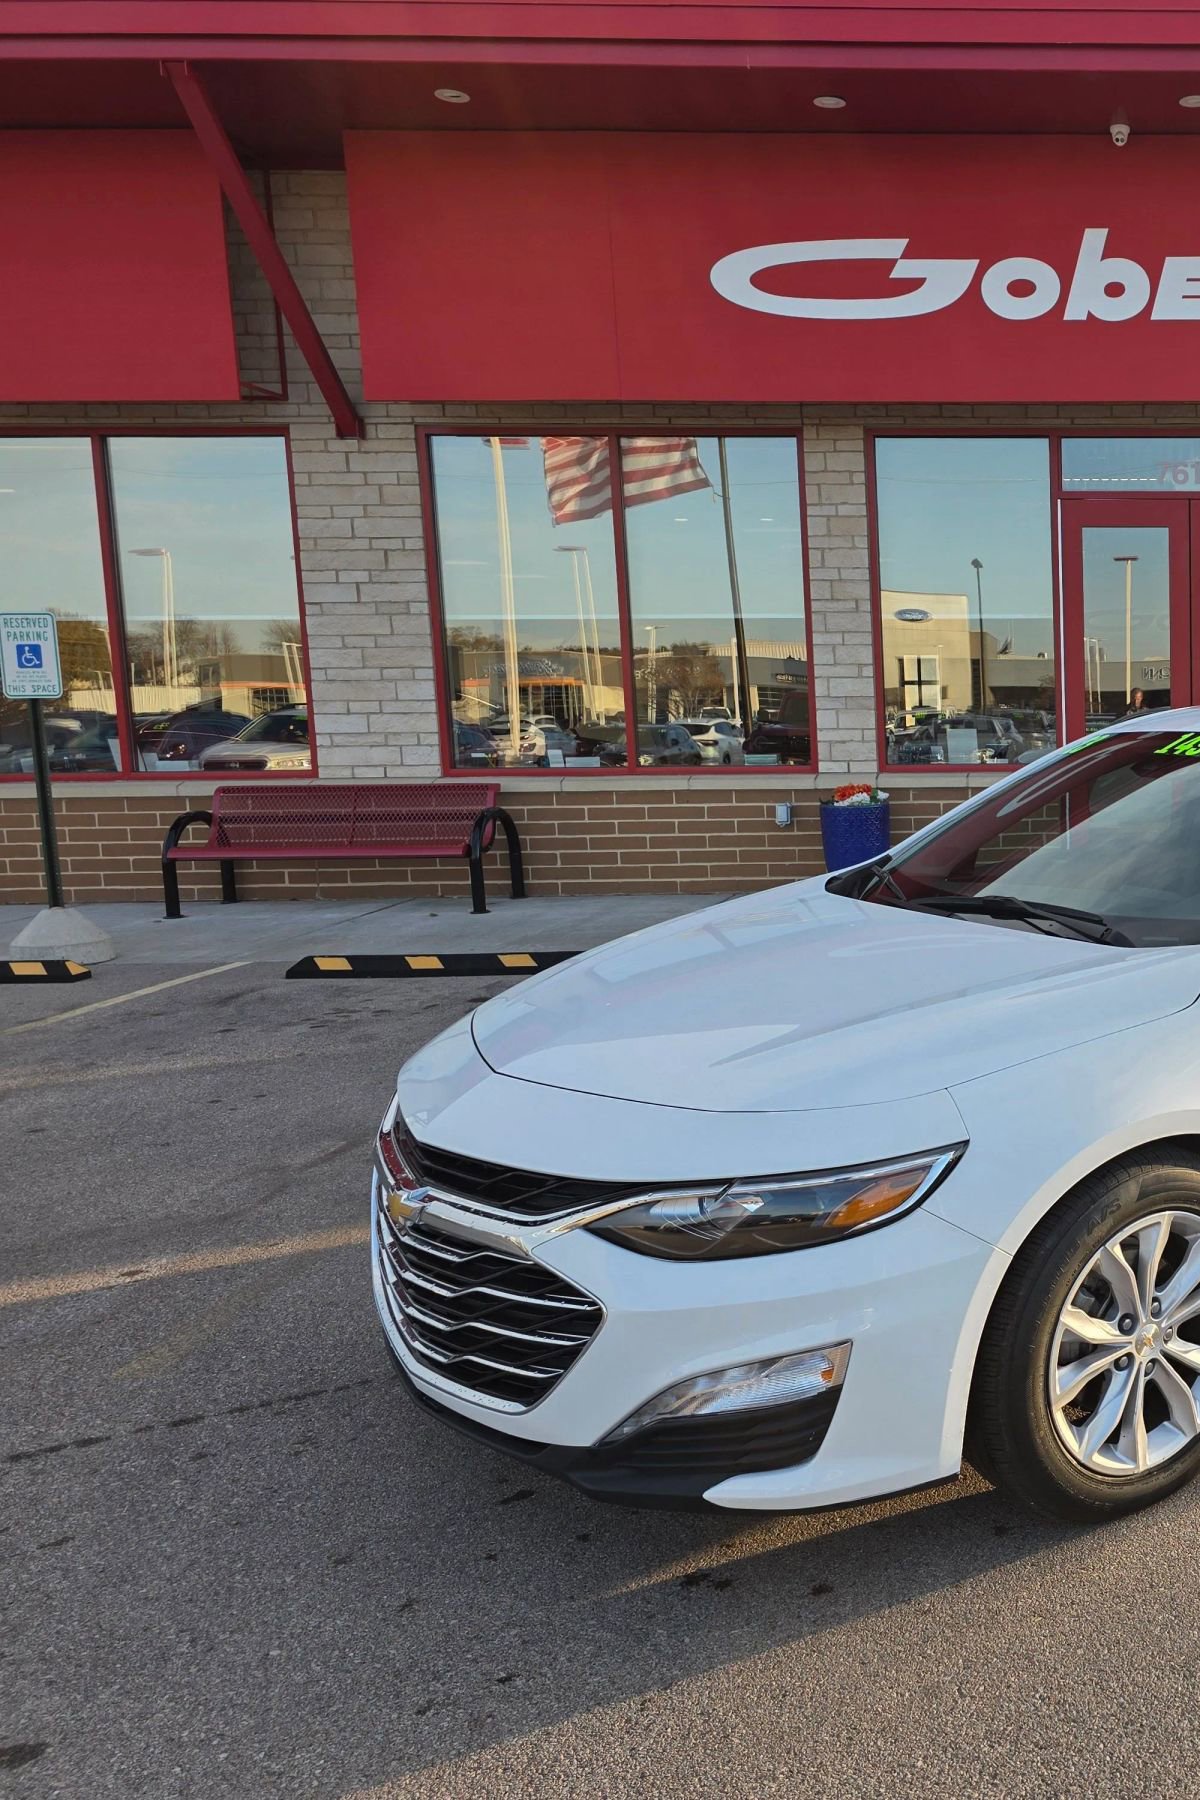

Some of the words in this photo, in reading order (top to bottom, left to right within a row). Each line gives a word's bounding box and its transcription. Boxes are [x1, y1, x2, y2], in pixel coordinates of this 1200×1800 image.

[3, 617, 49, 629] RESERVED
[6, 631, 49, 642] PARKING
[8, 684, 27, 694] THIS
[31, 684, 58, 694] SPACE
